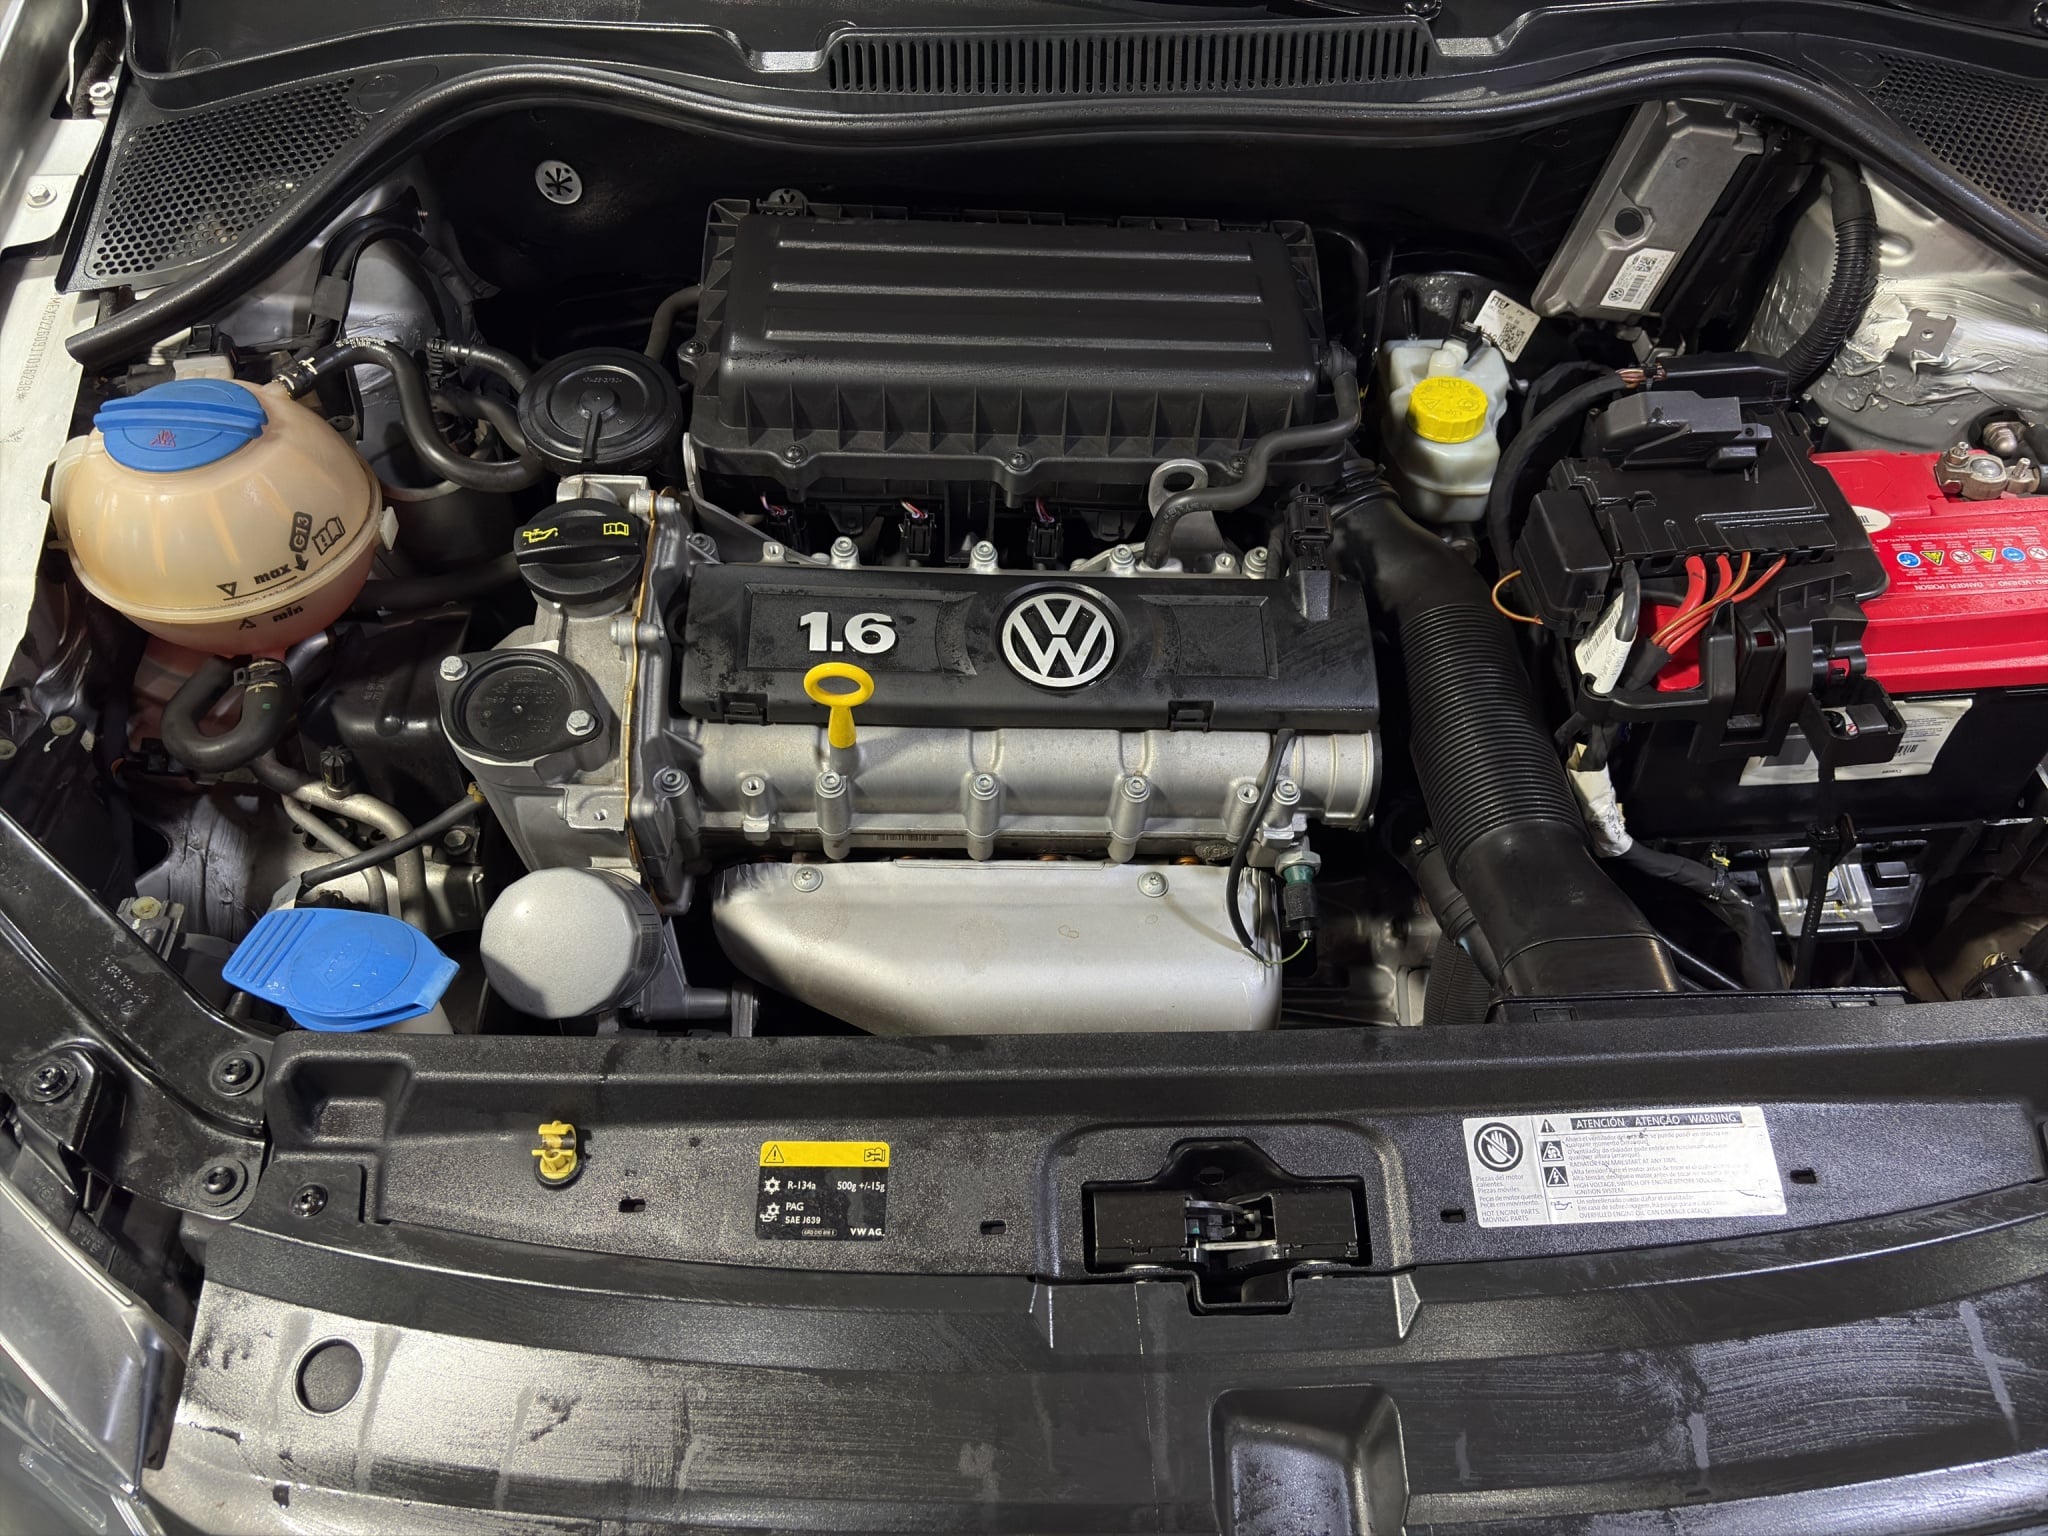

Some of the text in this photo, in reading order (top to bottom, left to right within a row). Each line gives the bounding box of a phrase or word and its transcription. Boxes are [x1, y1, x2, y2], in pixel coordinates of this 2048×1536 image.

[1490, 296, 1506, 310] FTE
[292, 515, 310, 551] G13
[253, 563, 292, 585] max
[272, 604, 304, 622] min
[799, 611, 897, 655] 1.6
[1001, 592, 1117, 688] VW
[1576, 1116, 1625, 1129] ATENCIÓN
[1688, 1113, 1737, 1124] WARNING
[787, 1180, 817, 1191] R-134a
[836, 1181, 857, 1192] 500g
[785, 1202, 805, 1212] PAG
[784, 1216, 821, 1225] SAE J639
[850, 1227, 867, 1237] VW
